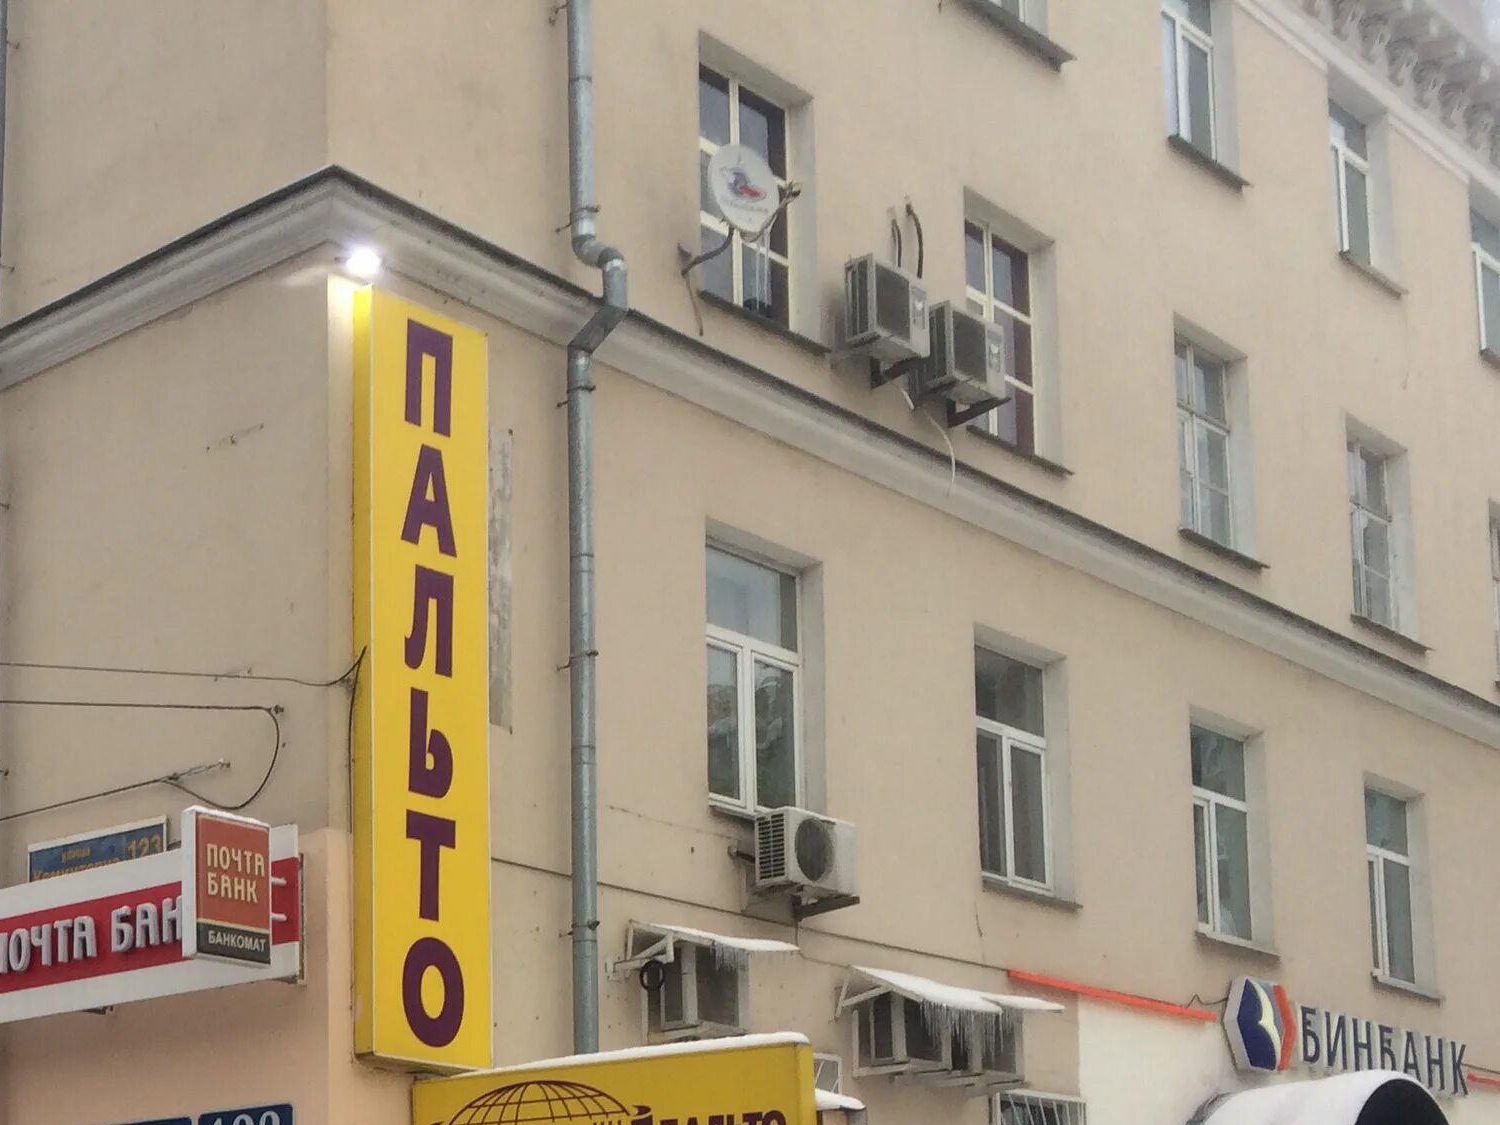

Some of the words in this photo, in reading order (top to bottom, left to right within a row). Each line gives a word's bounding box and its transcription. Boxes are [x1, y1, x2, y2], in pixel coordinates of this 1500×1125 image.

[401, 319, 464, 1048] ПАЛЬТО
[206, 843, 265, 877] ПОЧТА
[207, 873, 258, 903] БАНК
[111, 895, 182, 952] БАН
[207, 930, 266, 953] БАНКОМАТ
[1300, 1005, 1468, 1096] БИНБАНК
